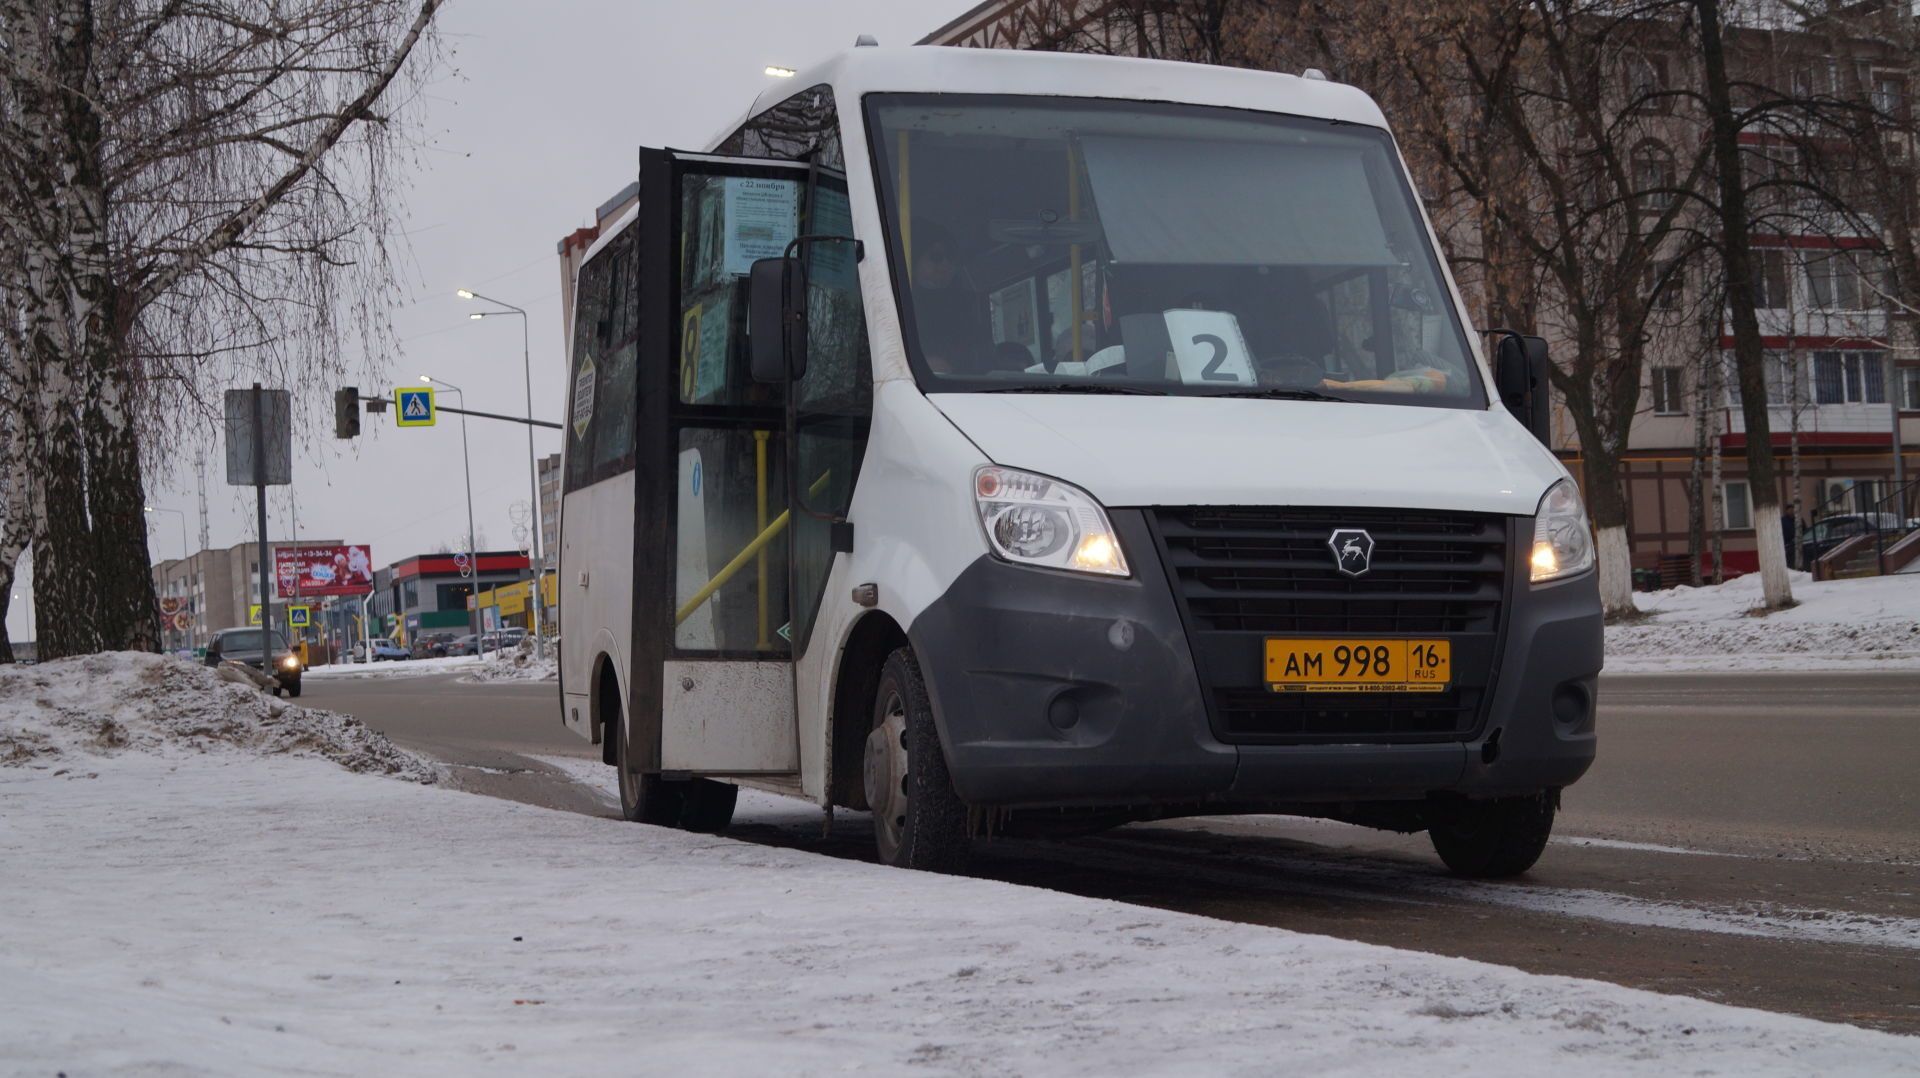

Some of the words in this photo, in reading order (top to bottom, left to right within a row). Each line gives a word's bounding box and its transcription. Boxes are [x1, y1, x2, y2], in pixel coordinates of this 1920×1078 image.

[1191, 333, 1239, 382] 2
[1284, 652, 1322, 676] АМ
[1333, 645, 1390, 676] 998
[1412, 644, 1439, 668] 16
[1415, 670, 1436, 679] RUS
